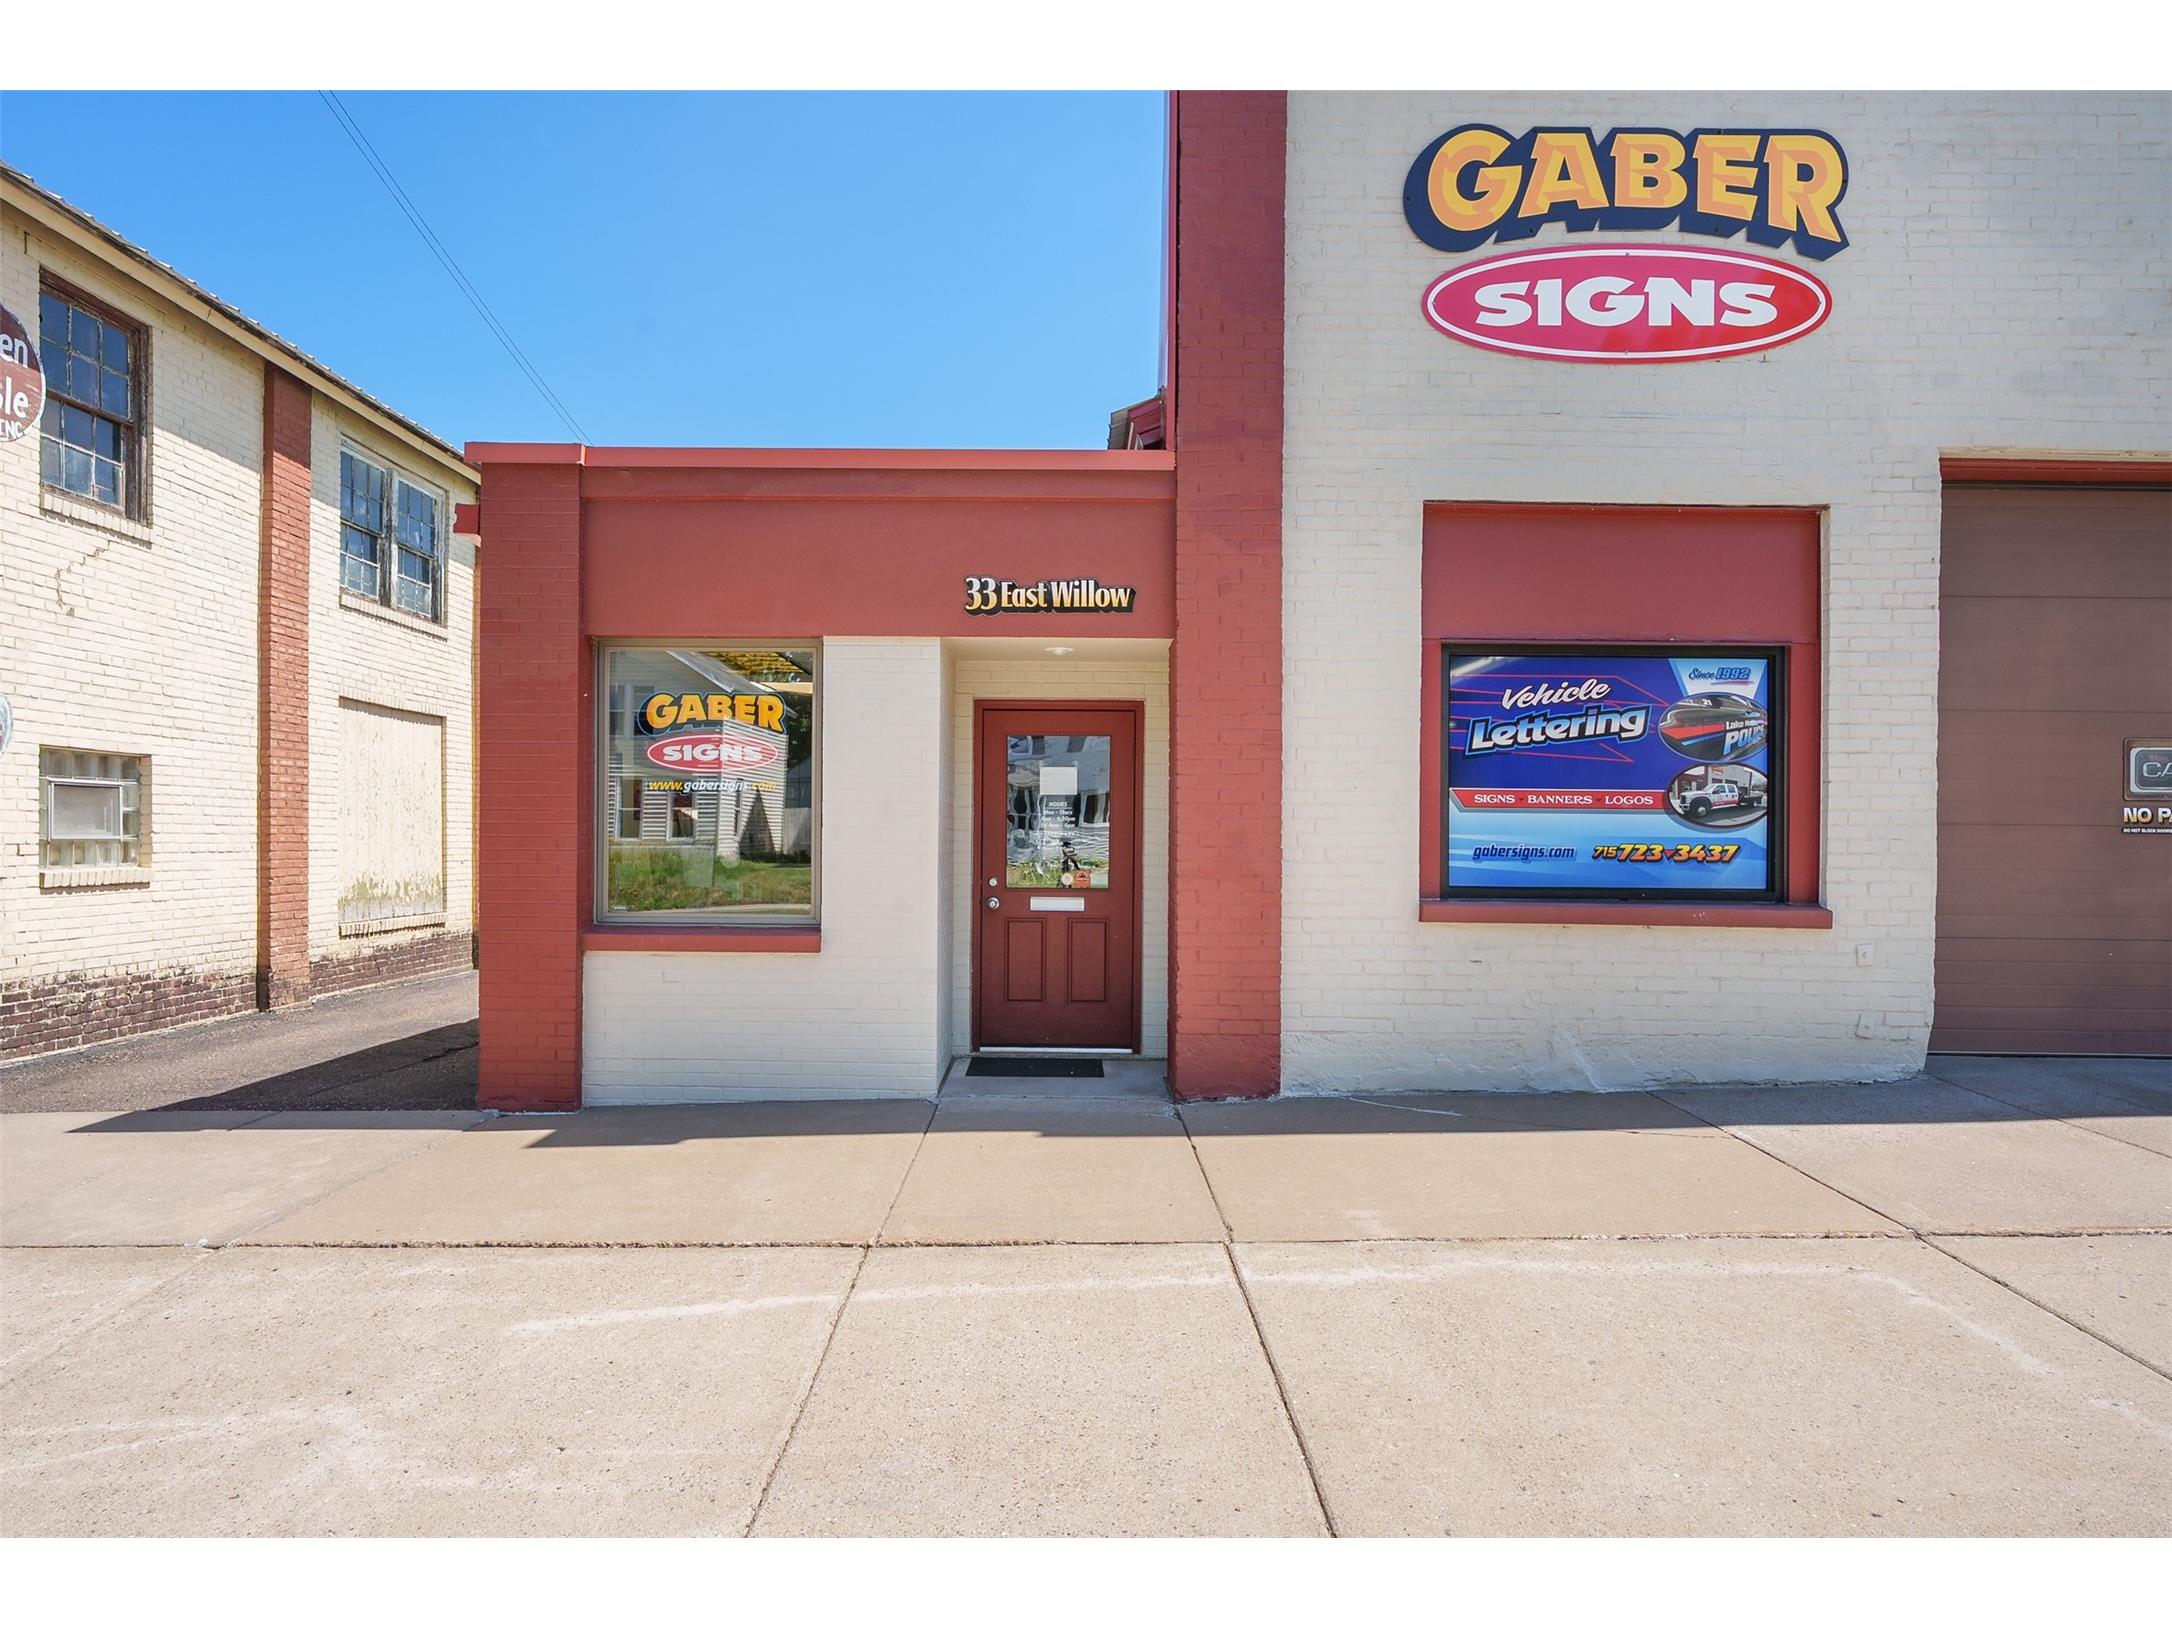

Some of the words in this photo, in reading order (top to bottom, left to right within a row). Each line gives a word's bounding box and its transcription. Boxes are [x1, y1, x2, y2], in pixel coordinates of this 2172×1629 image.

[1426, 128, 1846, 245] GABER
[1474, 275, 1778, 327] SIGNS
[0, 376, 29, 418] le
[965, 577, 999, 611] 33
[1000, 580, 1049, 608] East
[1050, 579, 1132, 608] Willow
[1689, 668, 1715, 680] Since
[1715, 668, 1751, 680] 1992
[1502, 678, 1611, 710] Vehicle
[645, 693, 785, 733] GABER
[1469, 704, 1654, 750] Lettering
[662, 743, 762, 763] SIGNS
[1474, 794, 1515, 804] SIGNS
[1527, 795, 1593, 804] BANNERS
[1605, 795, 1654, 805] LOGOS
[2123, 807, 2152, 823] NO
[1472, 843, 1576, 861] gabersigns.com
[1594, 846, 1618, 858] 715
